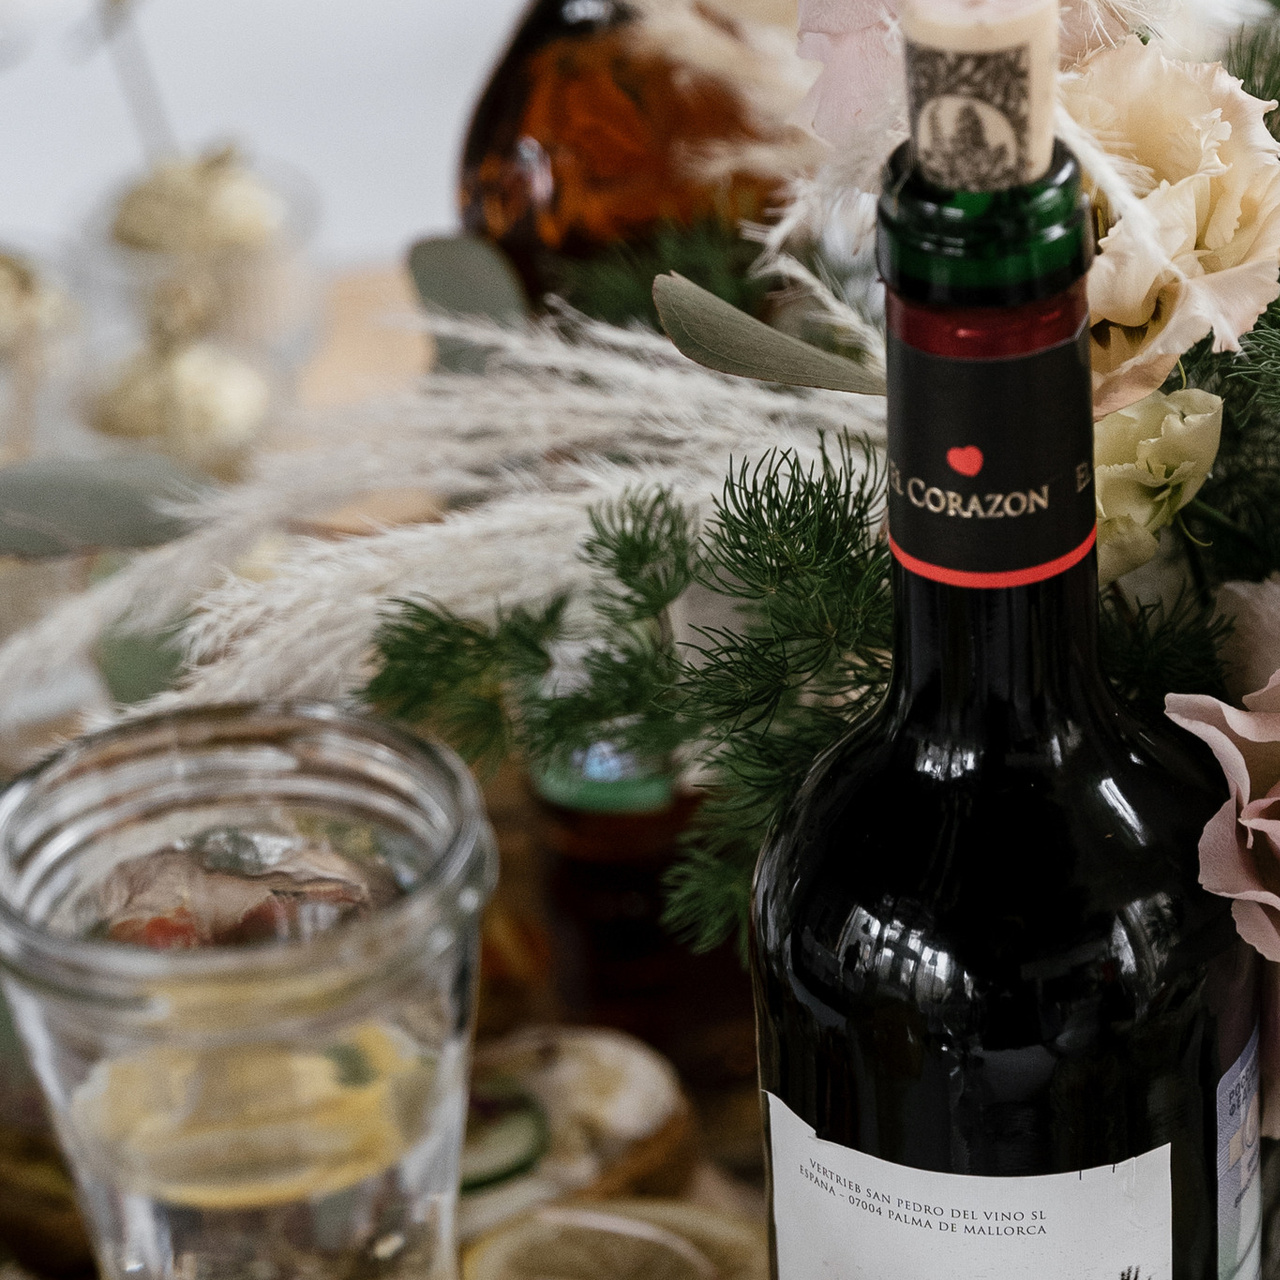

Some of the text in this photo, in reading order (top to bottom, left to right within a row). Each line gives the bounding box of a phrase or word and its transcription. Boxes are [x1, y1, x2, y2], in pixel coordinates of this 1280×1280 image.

[907, 476, 1050, 519] CORAZON
[799, 1164, 836, 1196] ESPANA
[848, 1195, 882, 1216] 07004
[888, 1210, 933, 1230] PALMA
[939, 1221, 957, 1233] DE
[964, 1224, 1047, 1236] MALLORCA
[809, 1157, 1047, 1221] VERTRIEB SAN PEDRO DEL VINO SL
